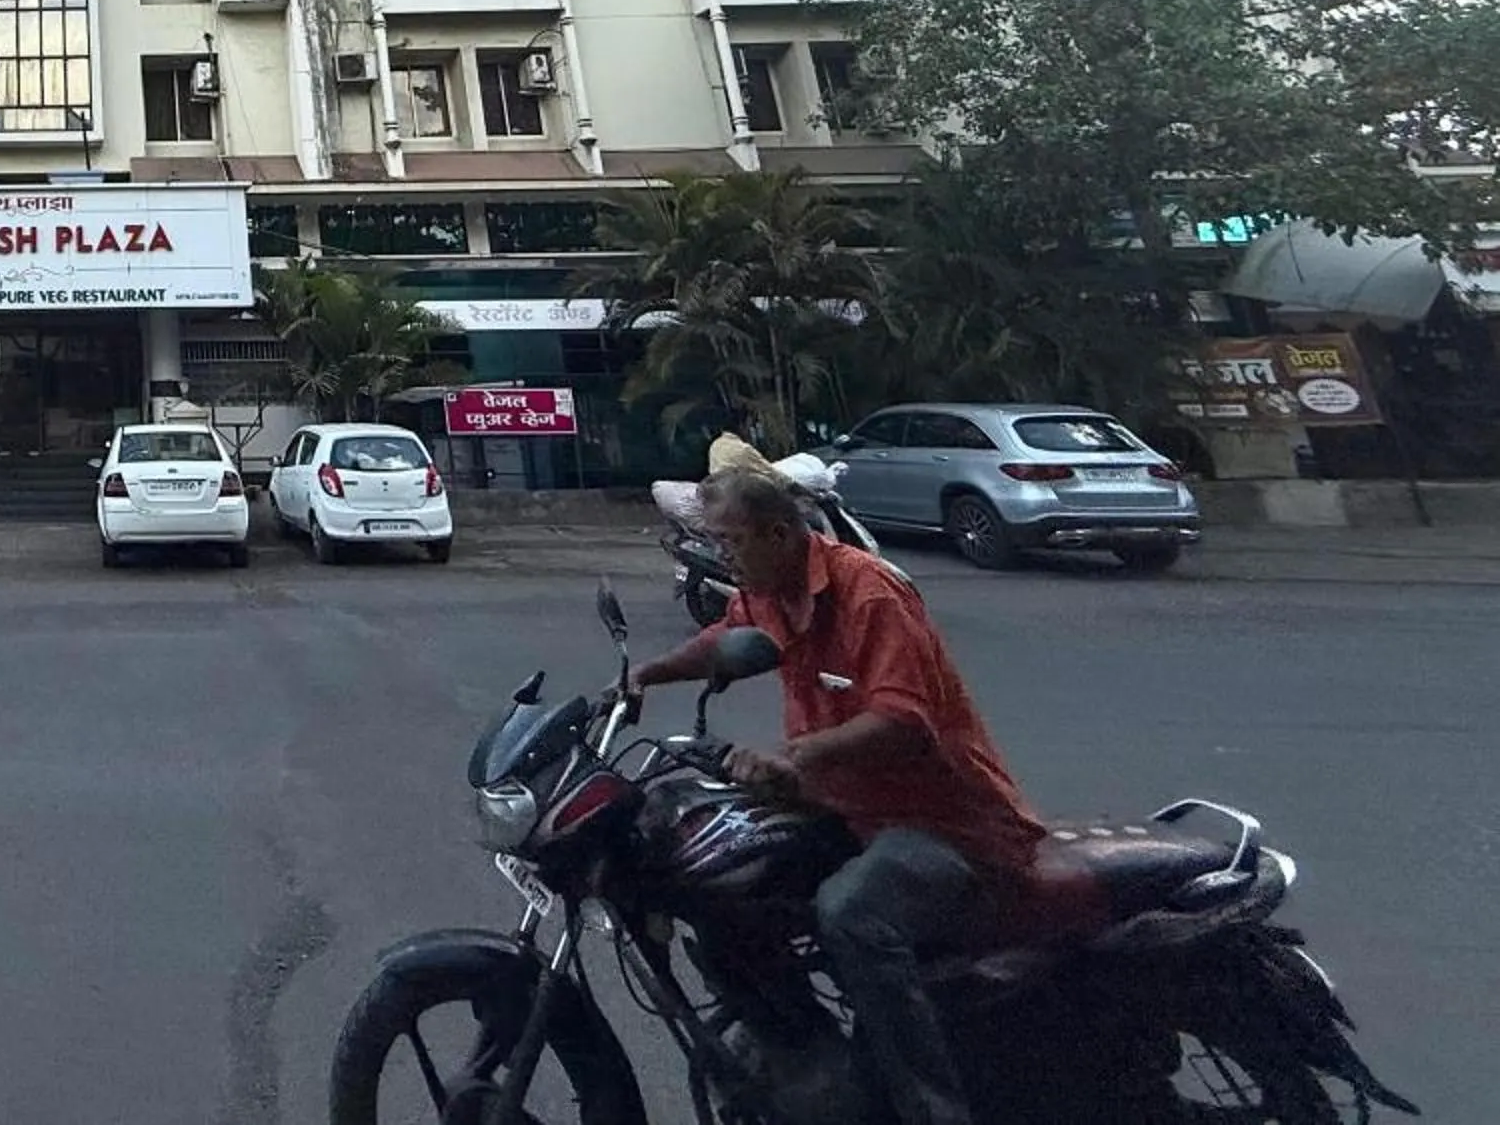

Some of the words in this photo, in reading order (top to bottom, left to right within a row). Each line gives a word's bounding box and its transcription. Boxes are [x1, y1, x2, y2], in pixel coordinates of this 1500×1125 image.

[16, 196, 74, 211] प्लाझा
[55, 223, 173, 254] PLAZA
[40, 290, 68, 303] VEG
[72, 288, 167, 302] RESTAURANT
[464, 412, 513, 430] प्युअर
[519, 408, 556, 428] व्हेज
